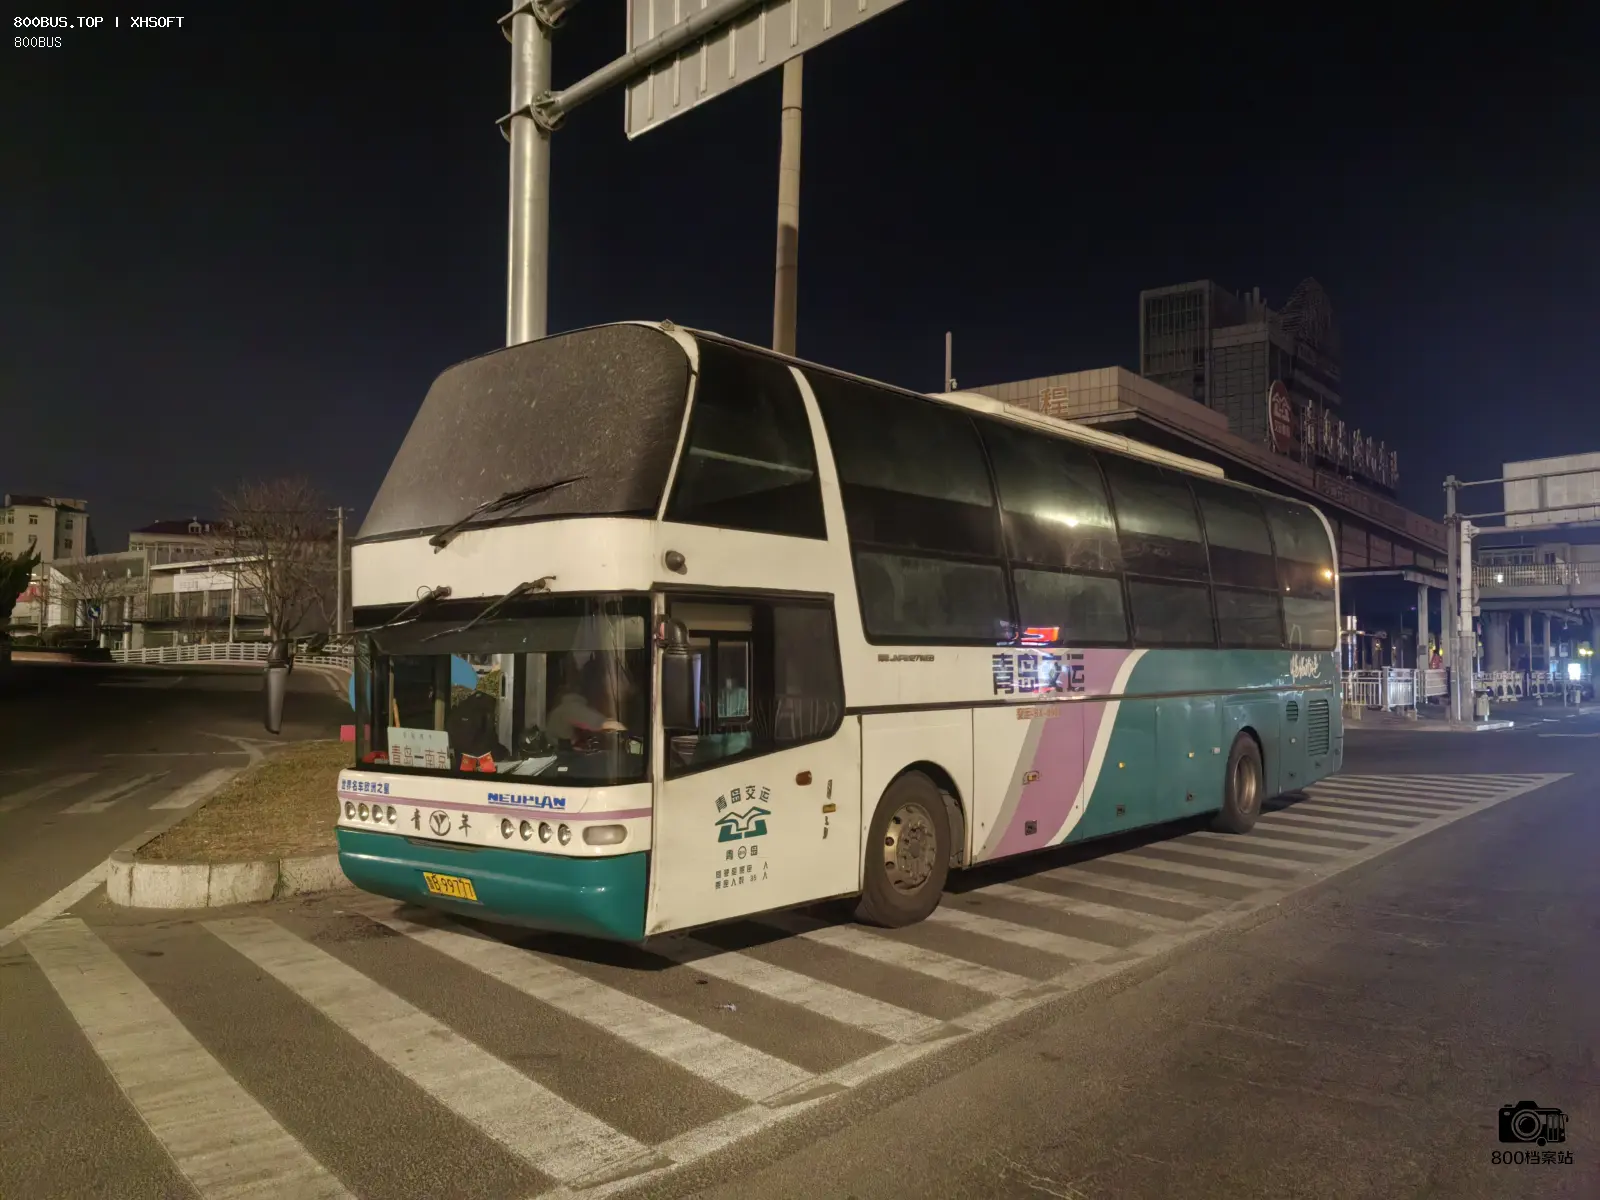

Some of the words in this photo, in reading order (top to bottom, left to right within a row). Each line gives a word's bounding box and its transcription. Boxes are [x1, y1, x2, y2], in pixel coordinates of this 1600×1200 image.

[992, 653, 1085, 695] 青岛交运
[714, 785, 771, 813] 青岛交运
